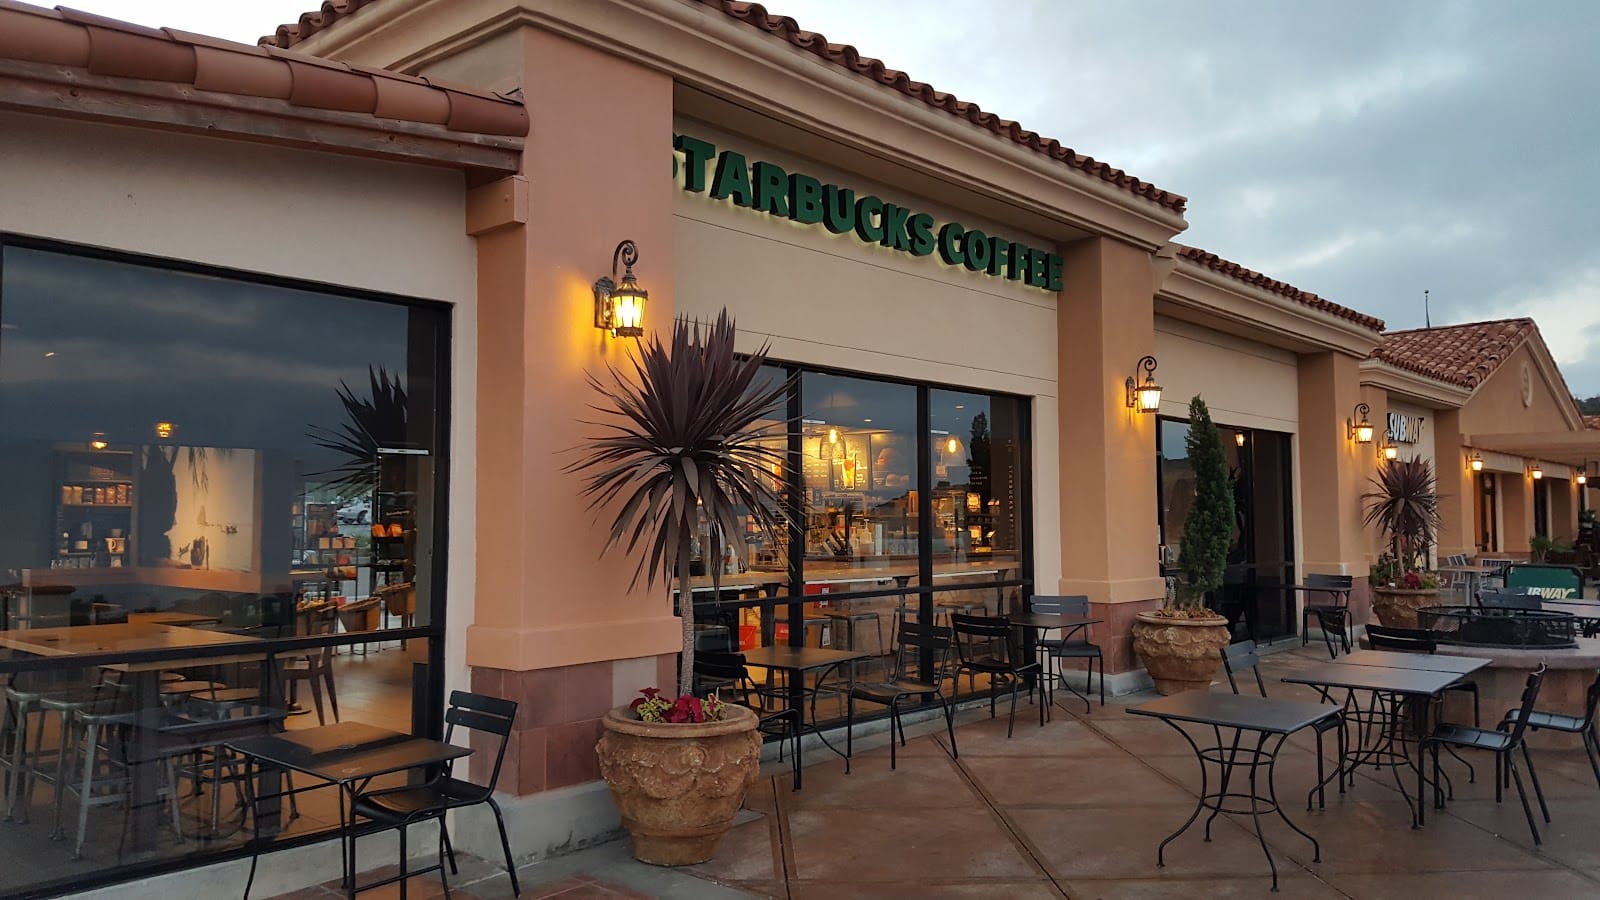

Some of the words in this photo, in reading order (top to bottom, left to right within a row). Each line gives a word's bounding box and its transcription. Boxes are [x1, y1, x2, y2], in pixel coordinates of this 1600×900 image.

[673, 132, 935, 257] TARBUCKS
[938, 222, 1064, 293] COFFEE
[1387, 412, 1425, 445] SUBWAY
[1514, 586, 1576, 600] BWAY
